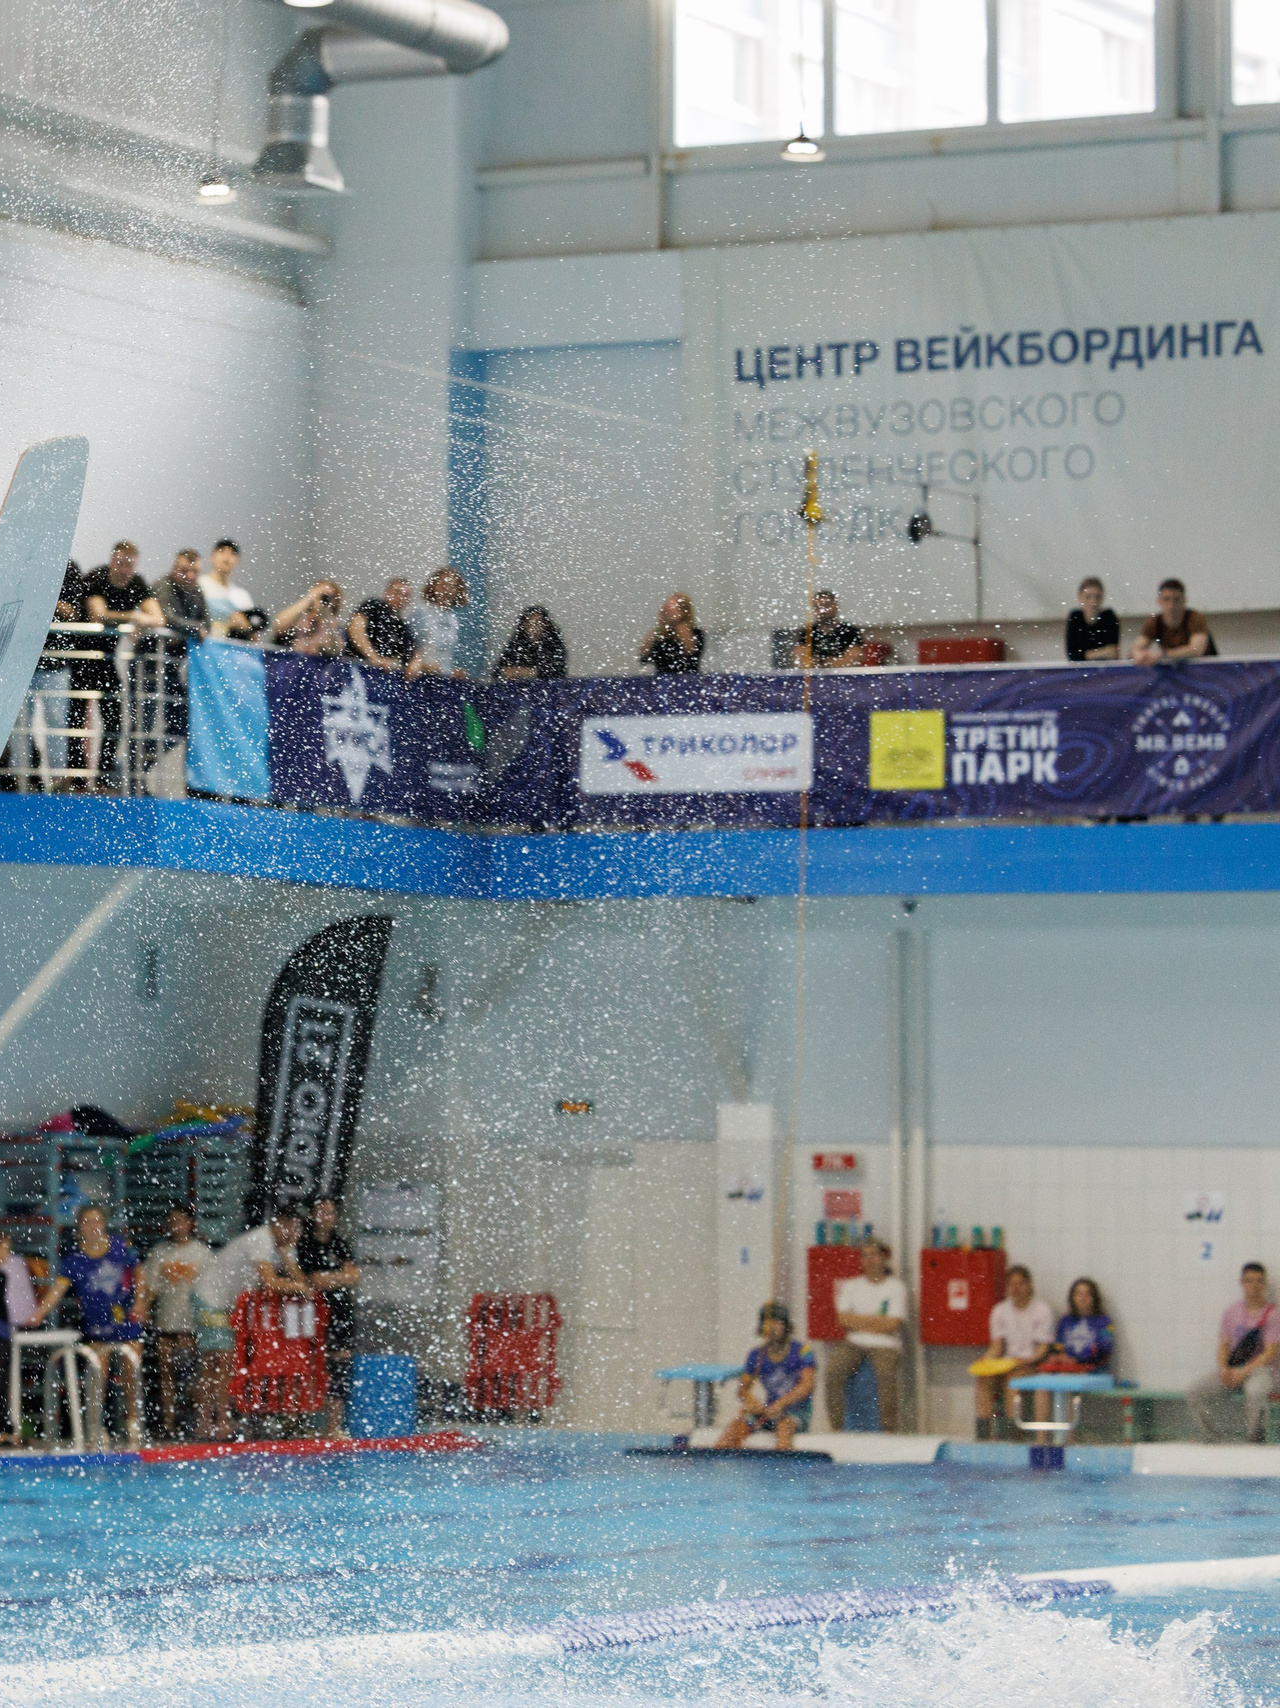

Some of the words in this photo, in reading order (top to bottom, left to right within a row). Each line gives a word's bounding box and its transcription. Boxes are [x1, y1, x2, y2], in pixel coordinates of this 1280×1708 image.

[734, 340, 880, 389] ЦЕНТР
[894, 318, 1264, 373] ВЕЙКБОРДИНГА
[733, 389, 1127, 443] МЕЖВУЗОВСКОГО
[733, 504, 918, 548] ГОРОДК
[951, 719, 1059, 750] ТРЕТИЙ
[951, 751, 1059, 785] ПАРК
